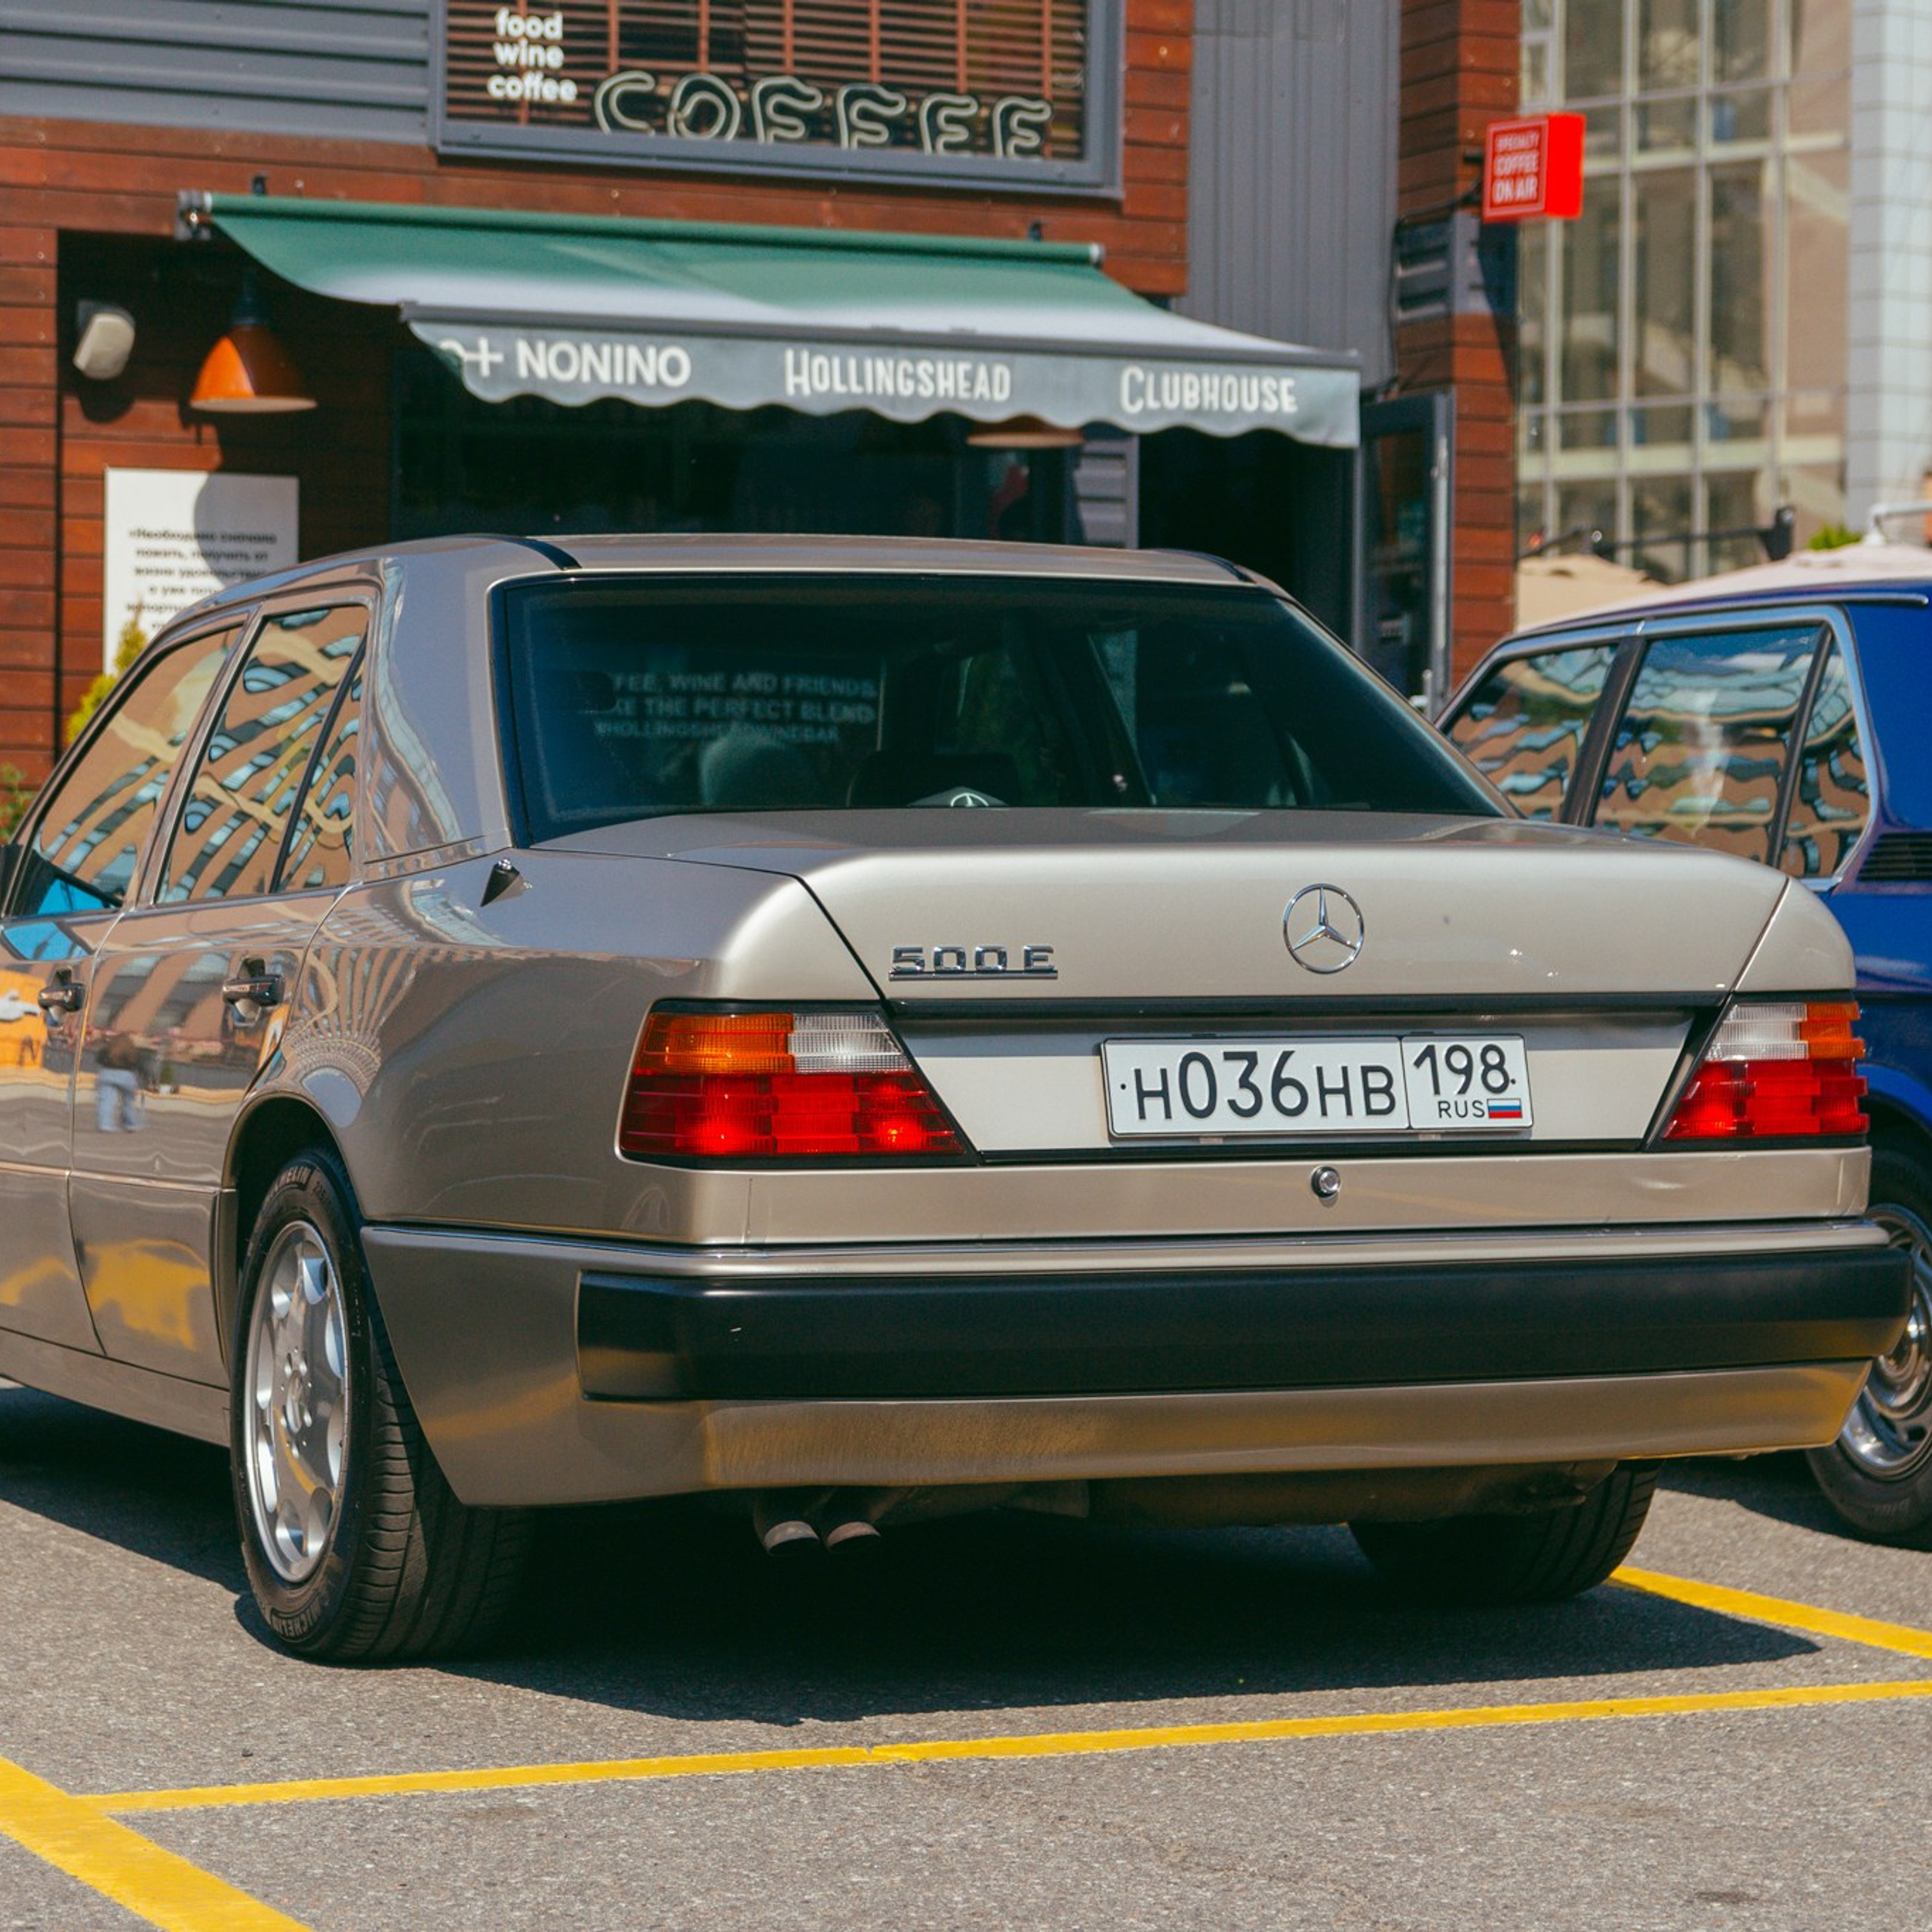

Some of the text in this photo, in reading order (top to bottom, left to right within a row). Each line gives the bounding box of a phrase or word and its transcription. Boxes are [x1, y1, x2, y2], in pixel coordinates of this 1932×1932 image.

[494, 7, 563, 40] food
[493, 38, 565, 69] wine
[486, 71, 577, 103] coffee
[1493, 149, 1539, 176] COFFEE
[1492, 174, 1538, 205] ON AIR
[515, 338, 691, 386] NONINO
[785, 348, 1012, 402] HOLLINGSHEAD
[1120, 365, 1298, 414] CLUBHOUSE
[733, 672, 777, 693] AND
[800, 700, 875, 724] BLEND
[889, 945, 1056, 972] 500 E
[1134, 1044, 1510, 1120] H036HB 198
[1438, 1099, 1485, 1119] RUS
